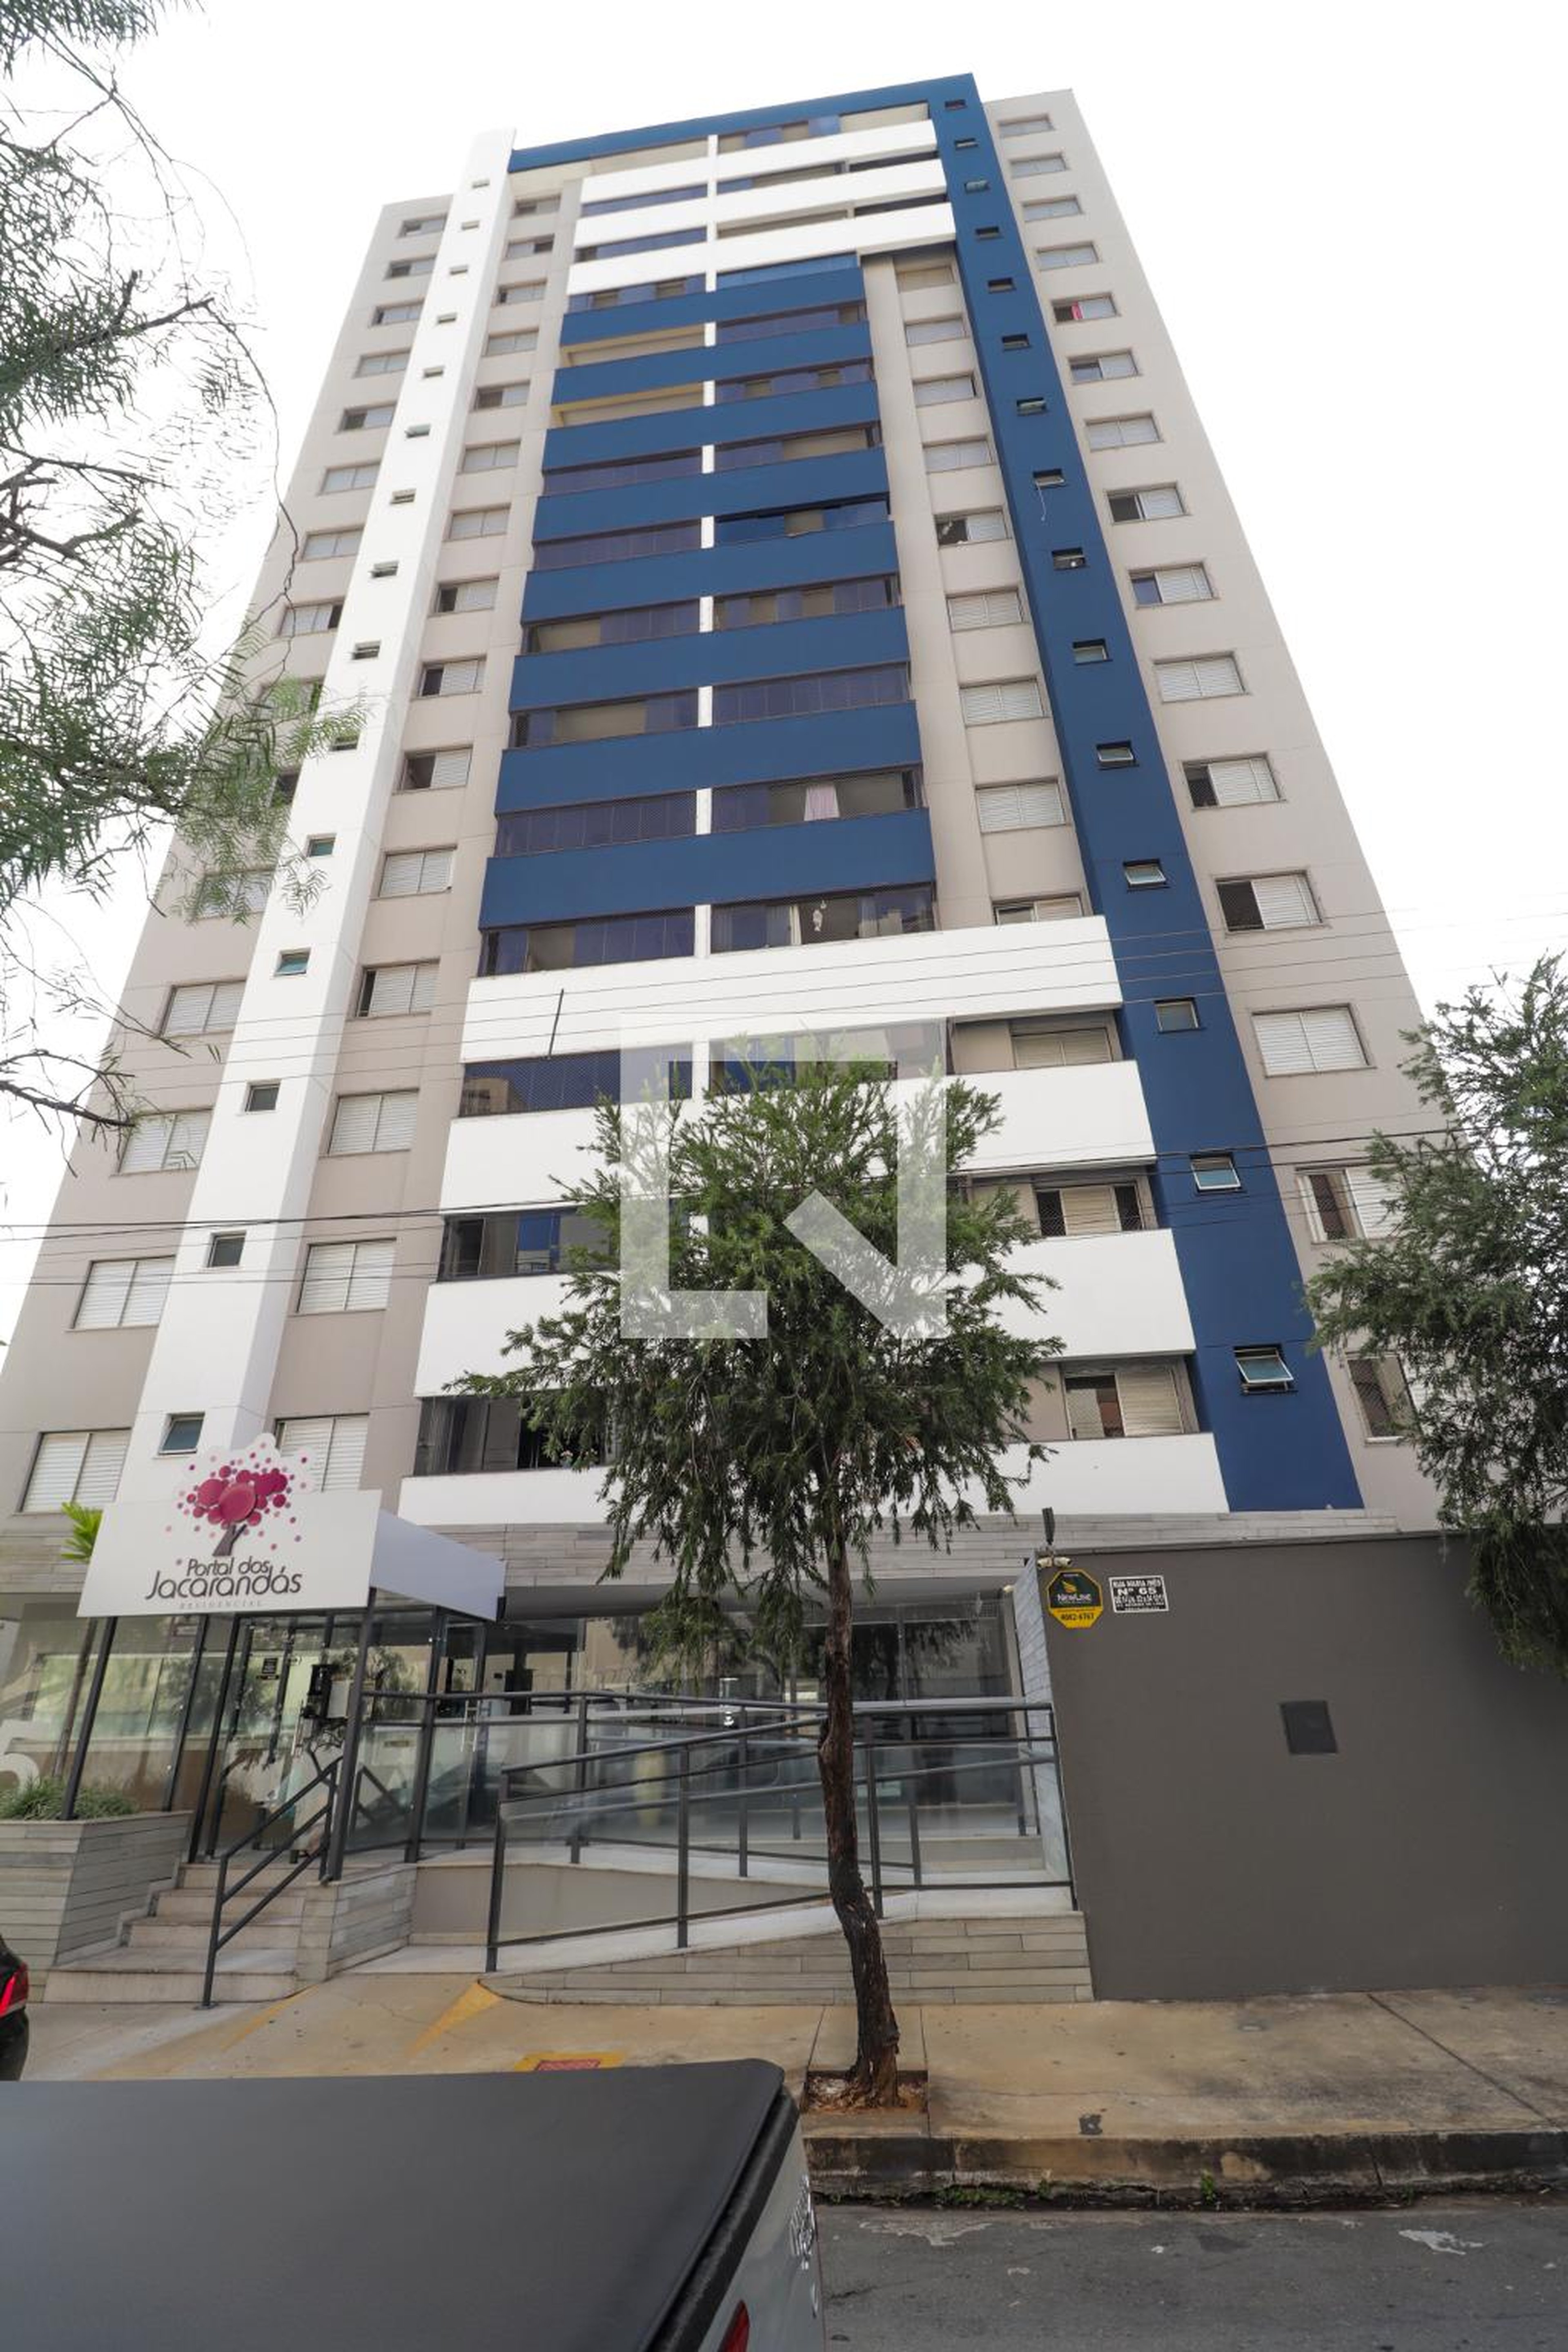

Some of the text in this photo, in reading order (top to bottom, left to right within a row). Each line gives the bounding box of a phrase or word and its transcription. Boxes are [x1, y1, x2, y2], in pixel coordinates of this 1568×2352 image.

[187, 1556, 270, 1577] Portal dos
[145, 1565, 303, 1599] Jacarandás
